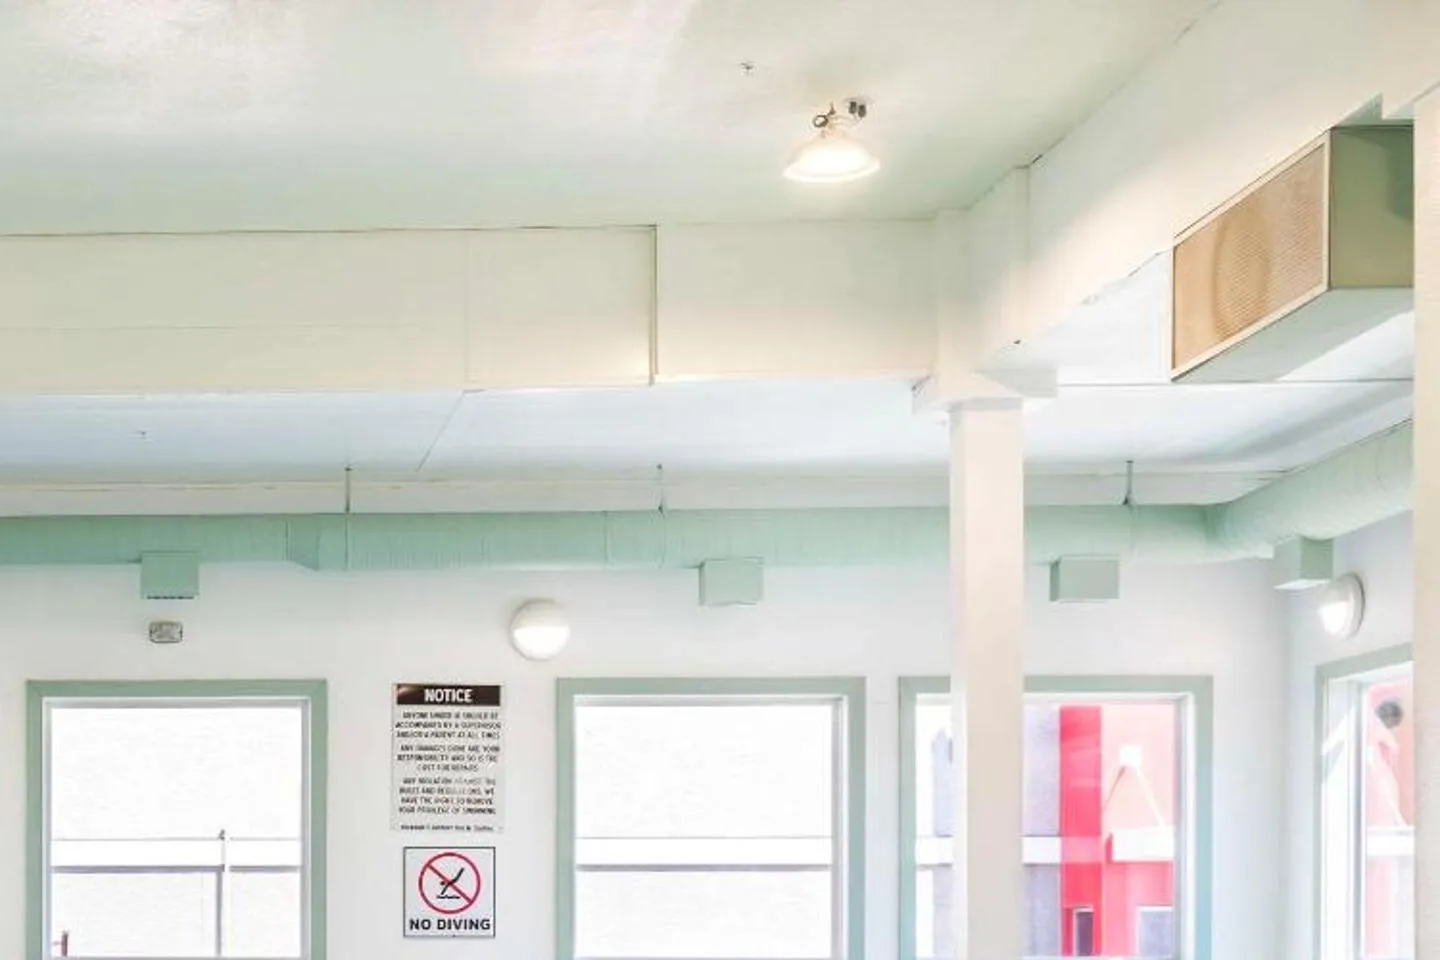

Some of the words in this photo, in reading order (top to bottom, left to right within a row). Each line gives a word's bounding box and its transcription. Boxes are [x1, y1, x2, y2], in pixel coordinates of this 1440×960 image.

[424, 688, 473, 702] NOTICE
[410, 919, 432, 930] NO
[437, 919, 491, 930] DIVING
